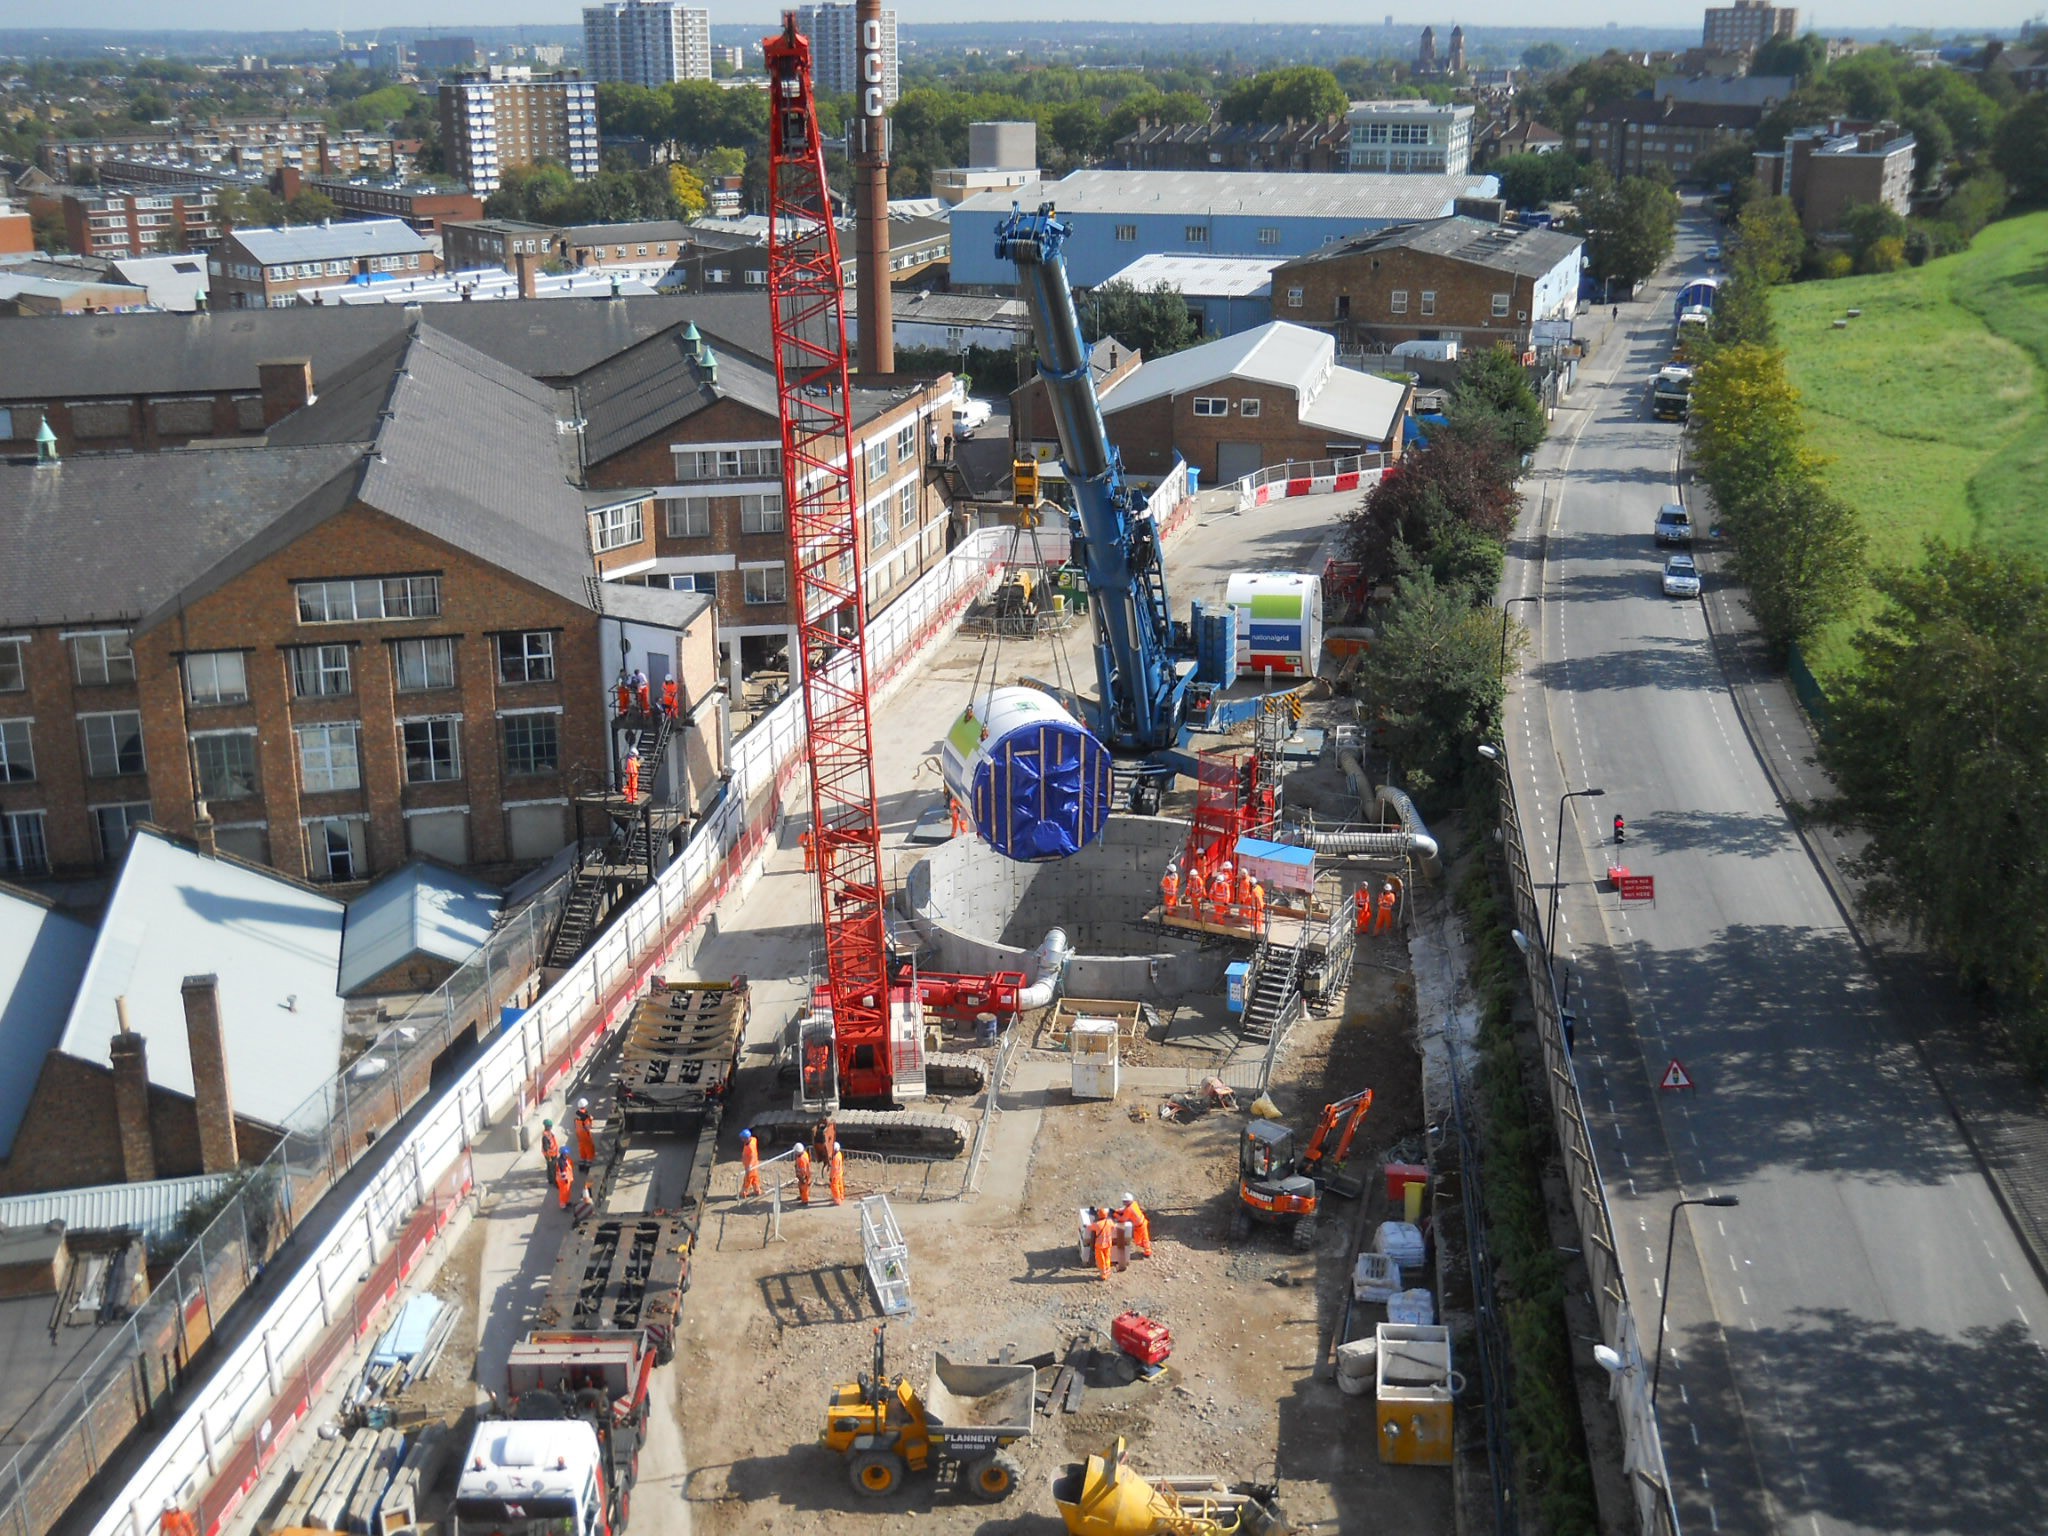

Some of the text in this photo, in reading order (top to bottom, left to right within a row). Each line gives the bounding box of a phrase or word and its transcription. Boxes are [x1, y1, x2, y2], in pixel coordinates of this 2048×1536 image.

[1252, 634, 1290, 642] nationalgrid
[1244, 1186, 1273, 1203] FLANNERY
[944, 1433, 997, 1442] FLANNERY
